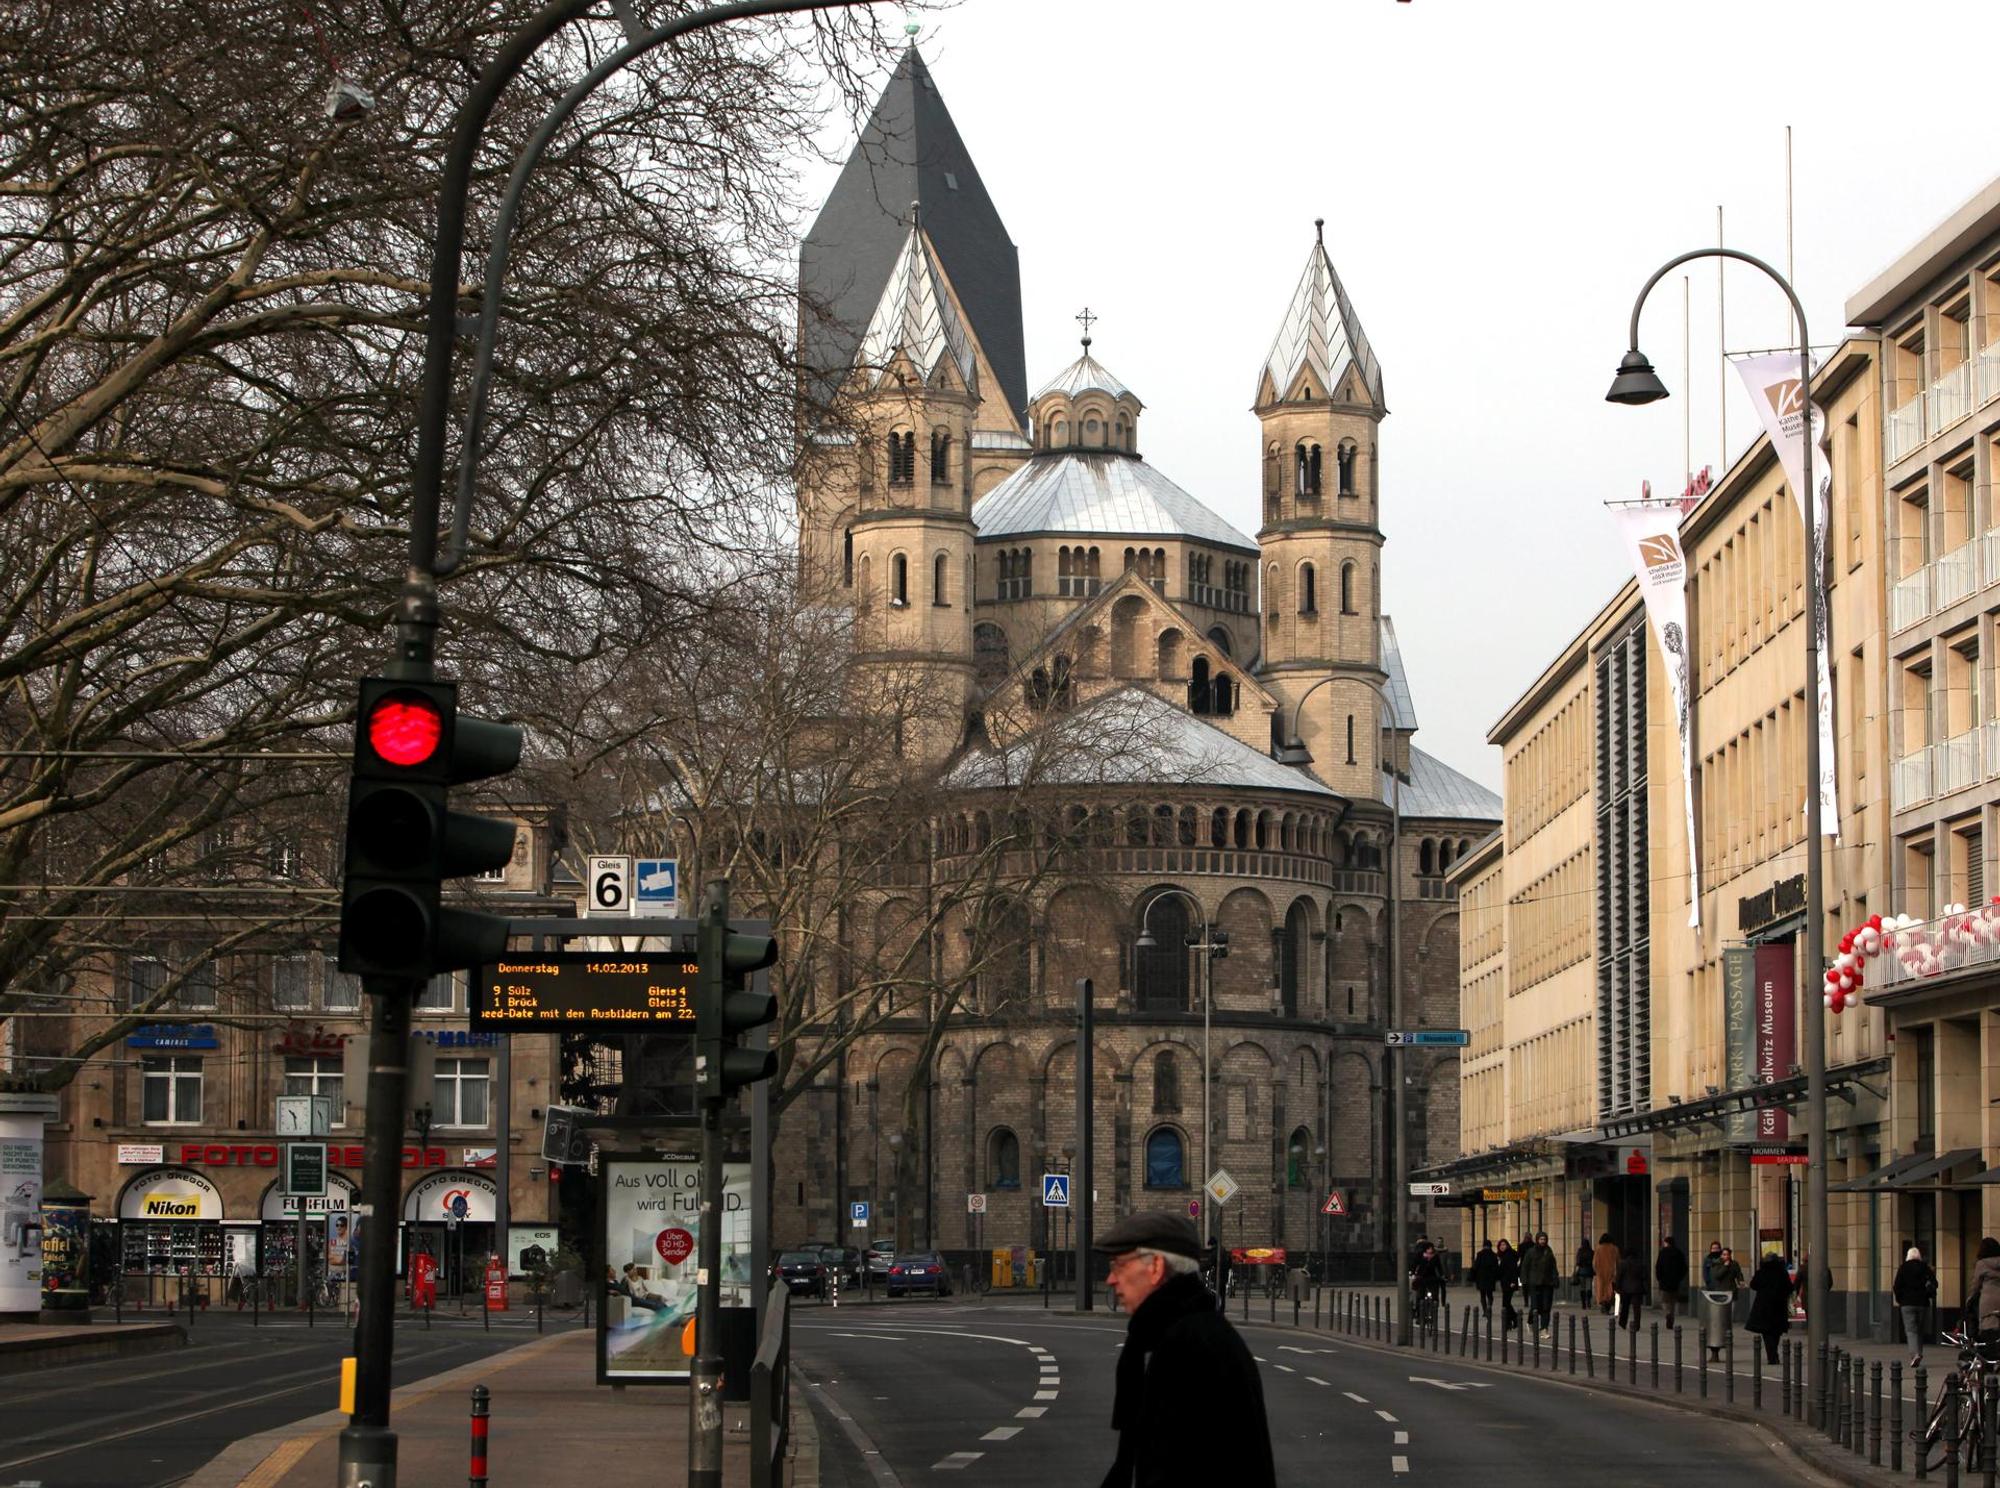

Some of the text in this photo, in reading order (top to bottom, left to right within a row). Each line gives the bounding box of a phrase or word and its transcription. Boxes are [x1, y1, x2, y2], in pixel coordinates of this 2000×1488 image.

[597, 860, 622, 869] Gleis
[596, 872, 622, 907] 6
[498, 963, 559, 975] Donnerstag
[586, 964, 648, 973] 14.02.2013
[493, 986, 686, 996] 9 Sülz Gleis 4
[494, 998, 686, 1008] 1 Brück Gleis 3
[1762, 981, 1773, 1034] Museum
[540, 1009, 559, 1018] mit
[566, 1009, 585, 1018] den
[592, 1009, 649, 1018] Ausbildern
[678, 1010, 696, 1018] 22.
[1729, 954, 1745, 1136] NEARKT PASSAGE
[1762, 1038, 1774, 1085] ollwitz
[181, 1144, 278, 1167] FOTO
[134, 1172, 211, 1193] FOTO GREGOR
[418, 1175, 497, 1196] FOTO GREGOR
[615, 1174, 640, 1188] Aus
[645, 1168, 678, 1188] voll
[147, 1201, 196, 1216] Nikon
[284, 1199, 345, 1210] FUIFILM
[637, 1195, 666, 1211] wird
[673, 1192, 701, 1211] Ful
[856, 1205, 864, 1218] P
[666, 1231, 684, 1240] Über
[663, 1248, 687, 1256] Sender
